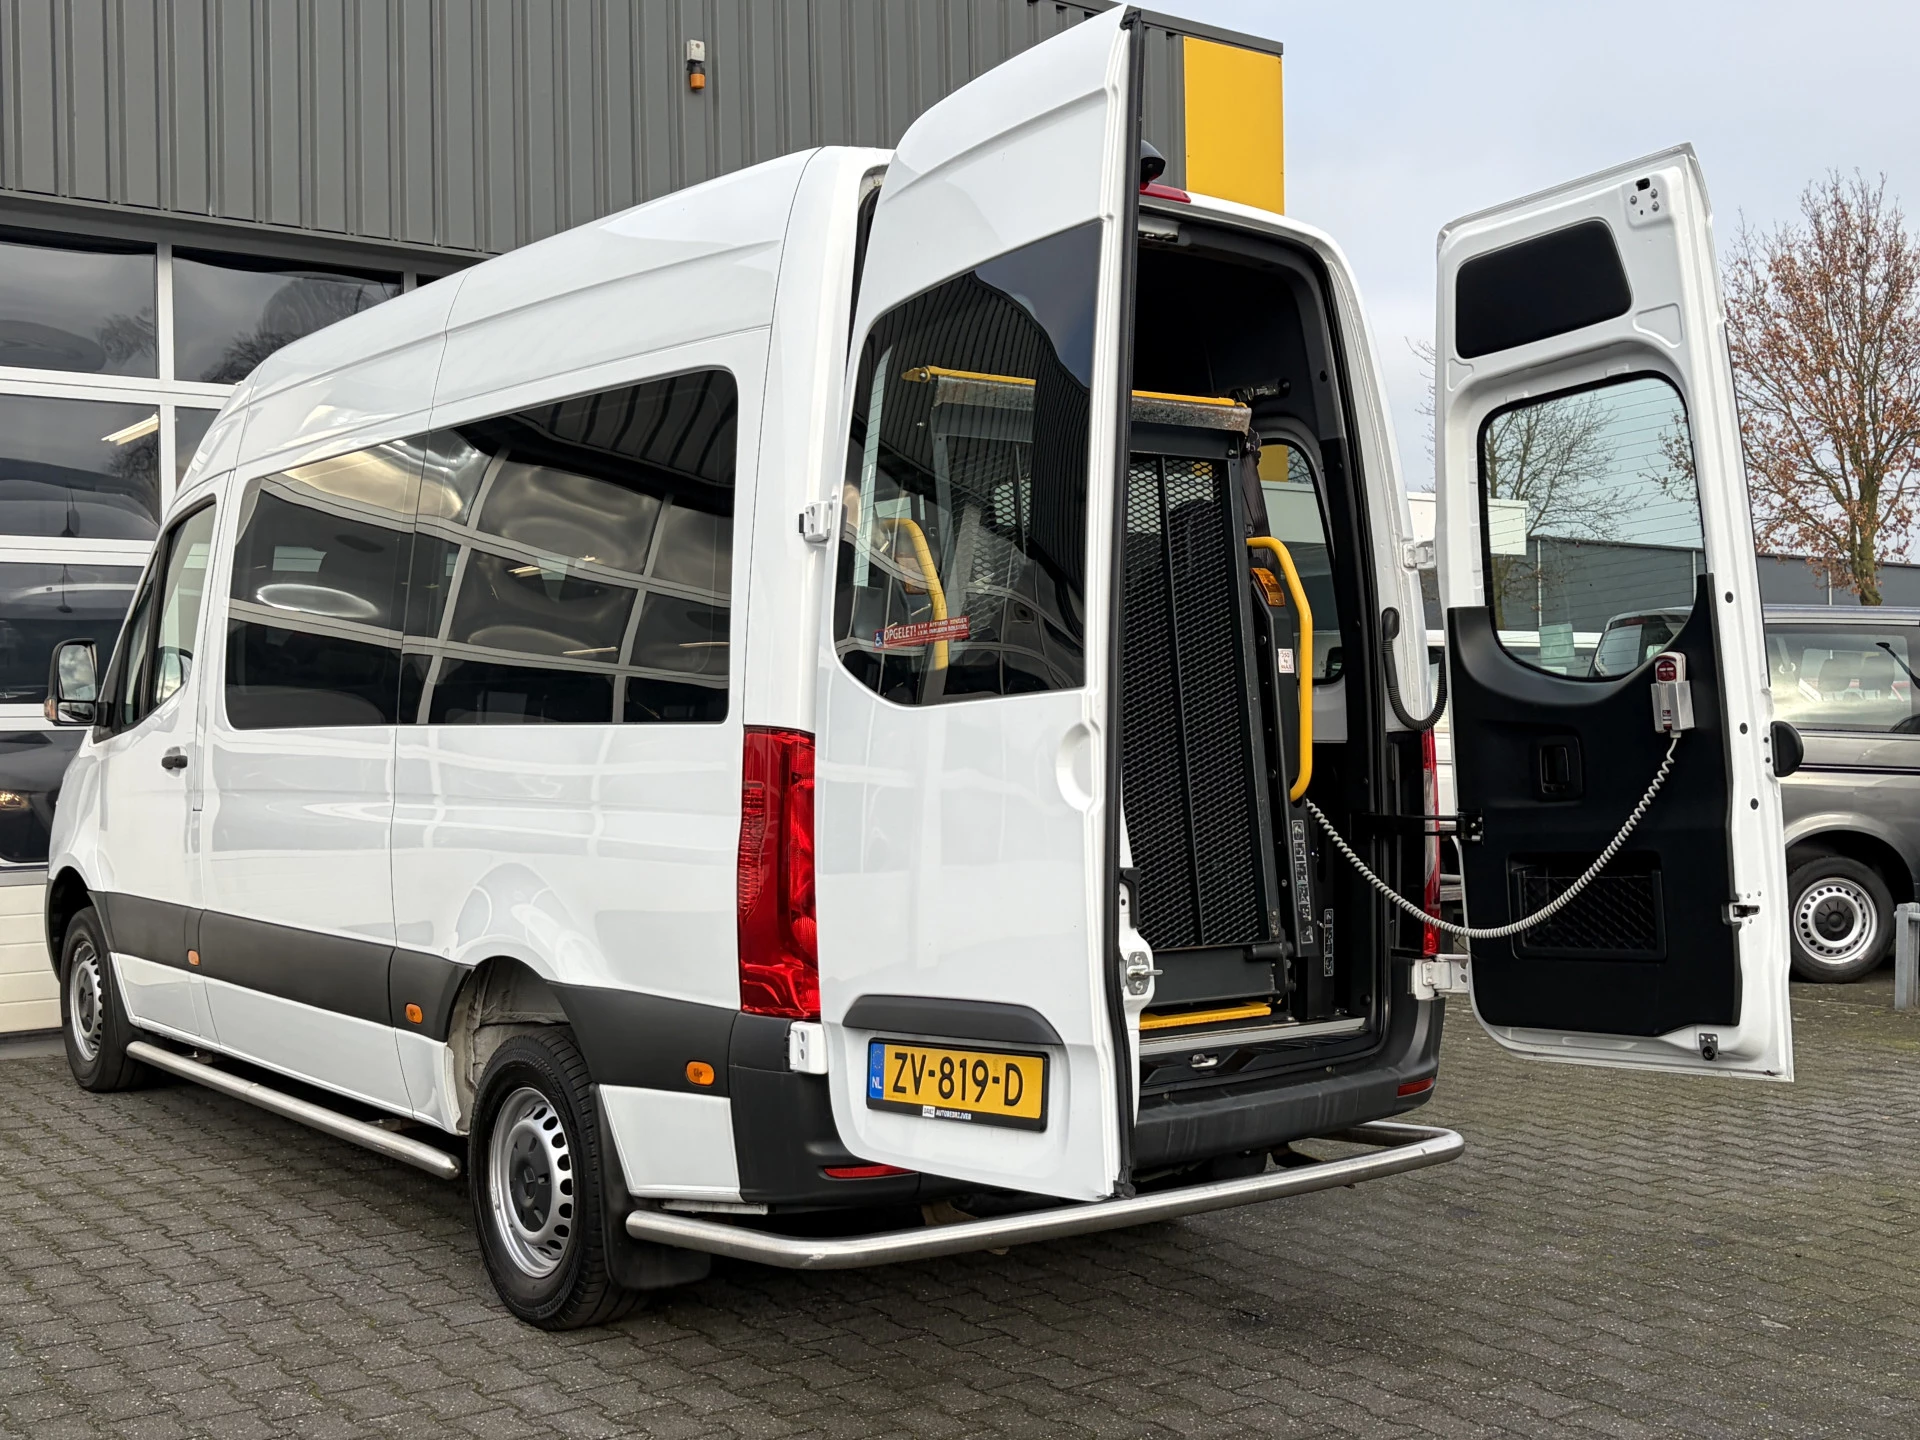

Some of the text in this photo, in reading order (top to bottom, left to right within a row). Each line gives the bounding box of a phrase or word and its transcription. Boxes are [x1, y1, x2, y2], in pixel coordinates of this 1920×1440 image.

[885, 626, 916, 640] OPGELET!
[871, 1076, 882, 1089] NL
[893, 1052, 1023, 1106] ZV-819-D
